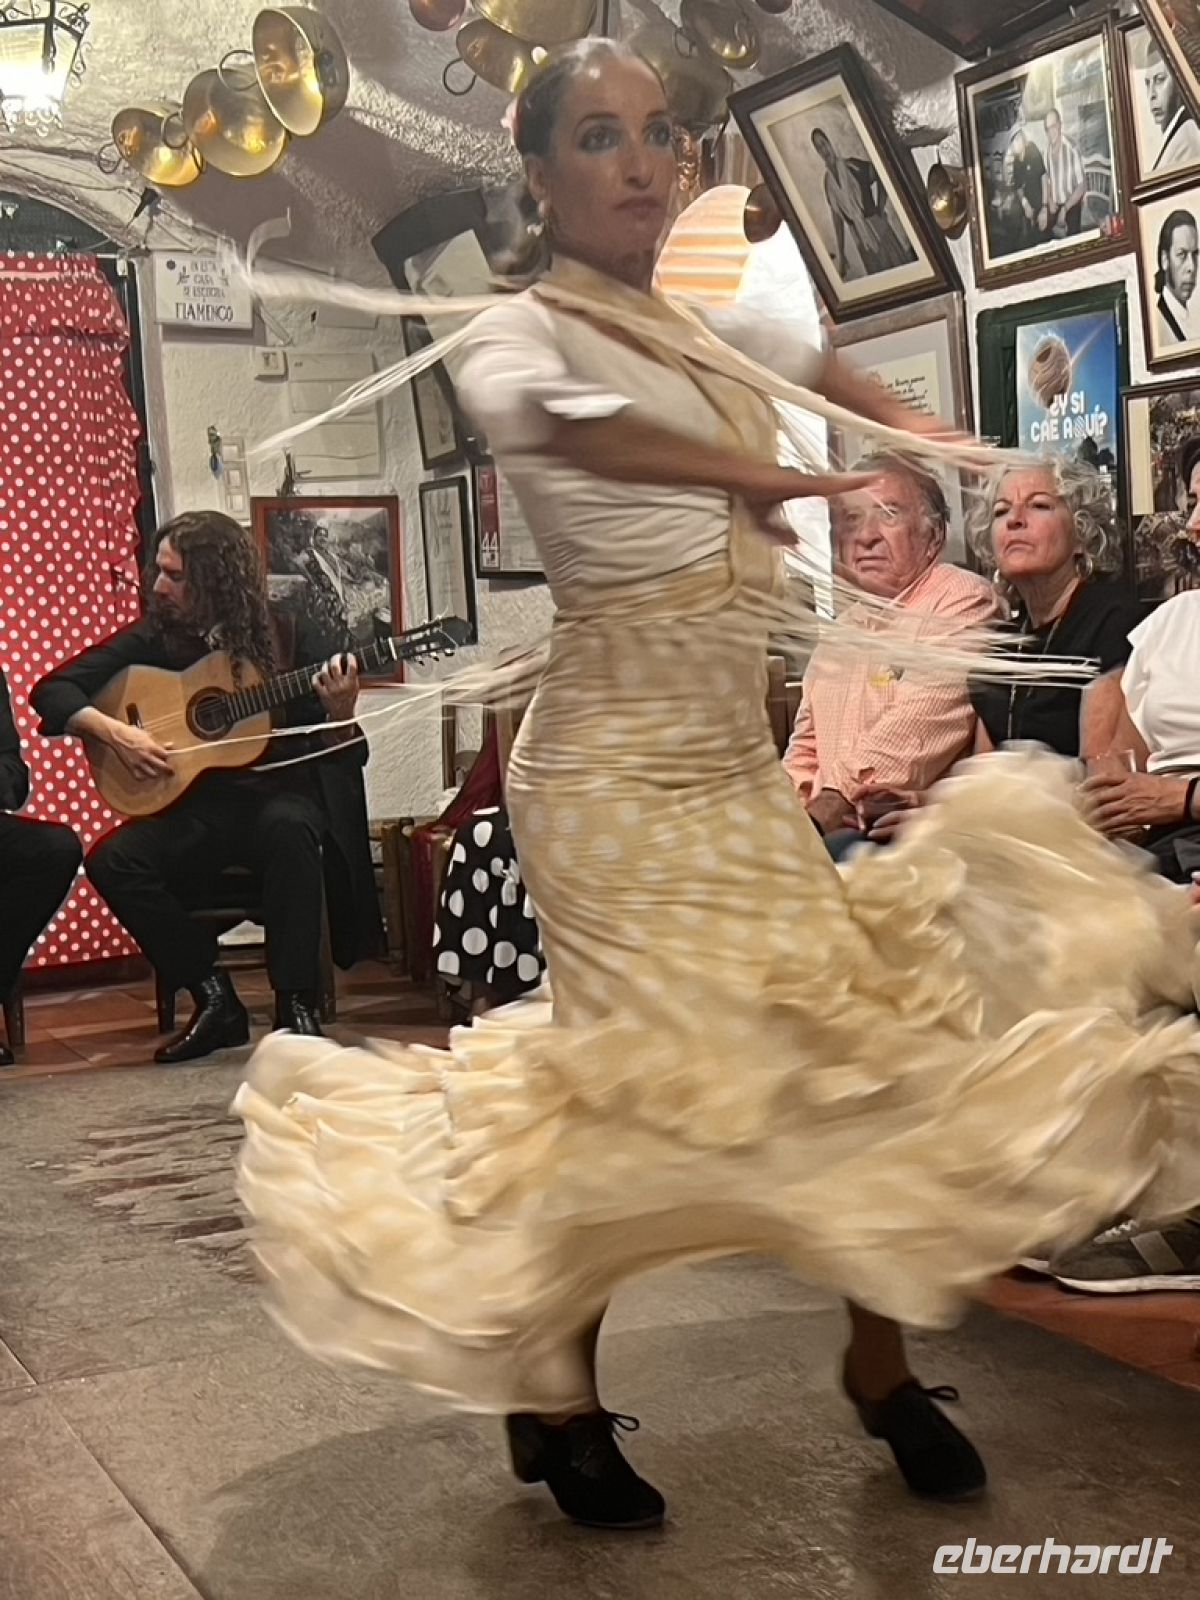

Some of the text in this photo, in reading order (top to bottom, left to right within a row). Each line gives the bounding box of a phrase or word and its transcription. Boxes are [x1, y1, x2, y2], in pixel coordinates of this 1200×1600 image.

[175, 302, 234, 322] FLAMENCO
[1049, 390, 1085, 417] ¿Y SI
[1030, 404, 1109, 443] CAE AQUÍ?
